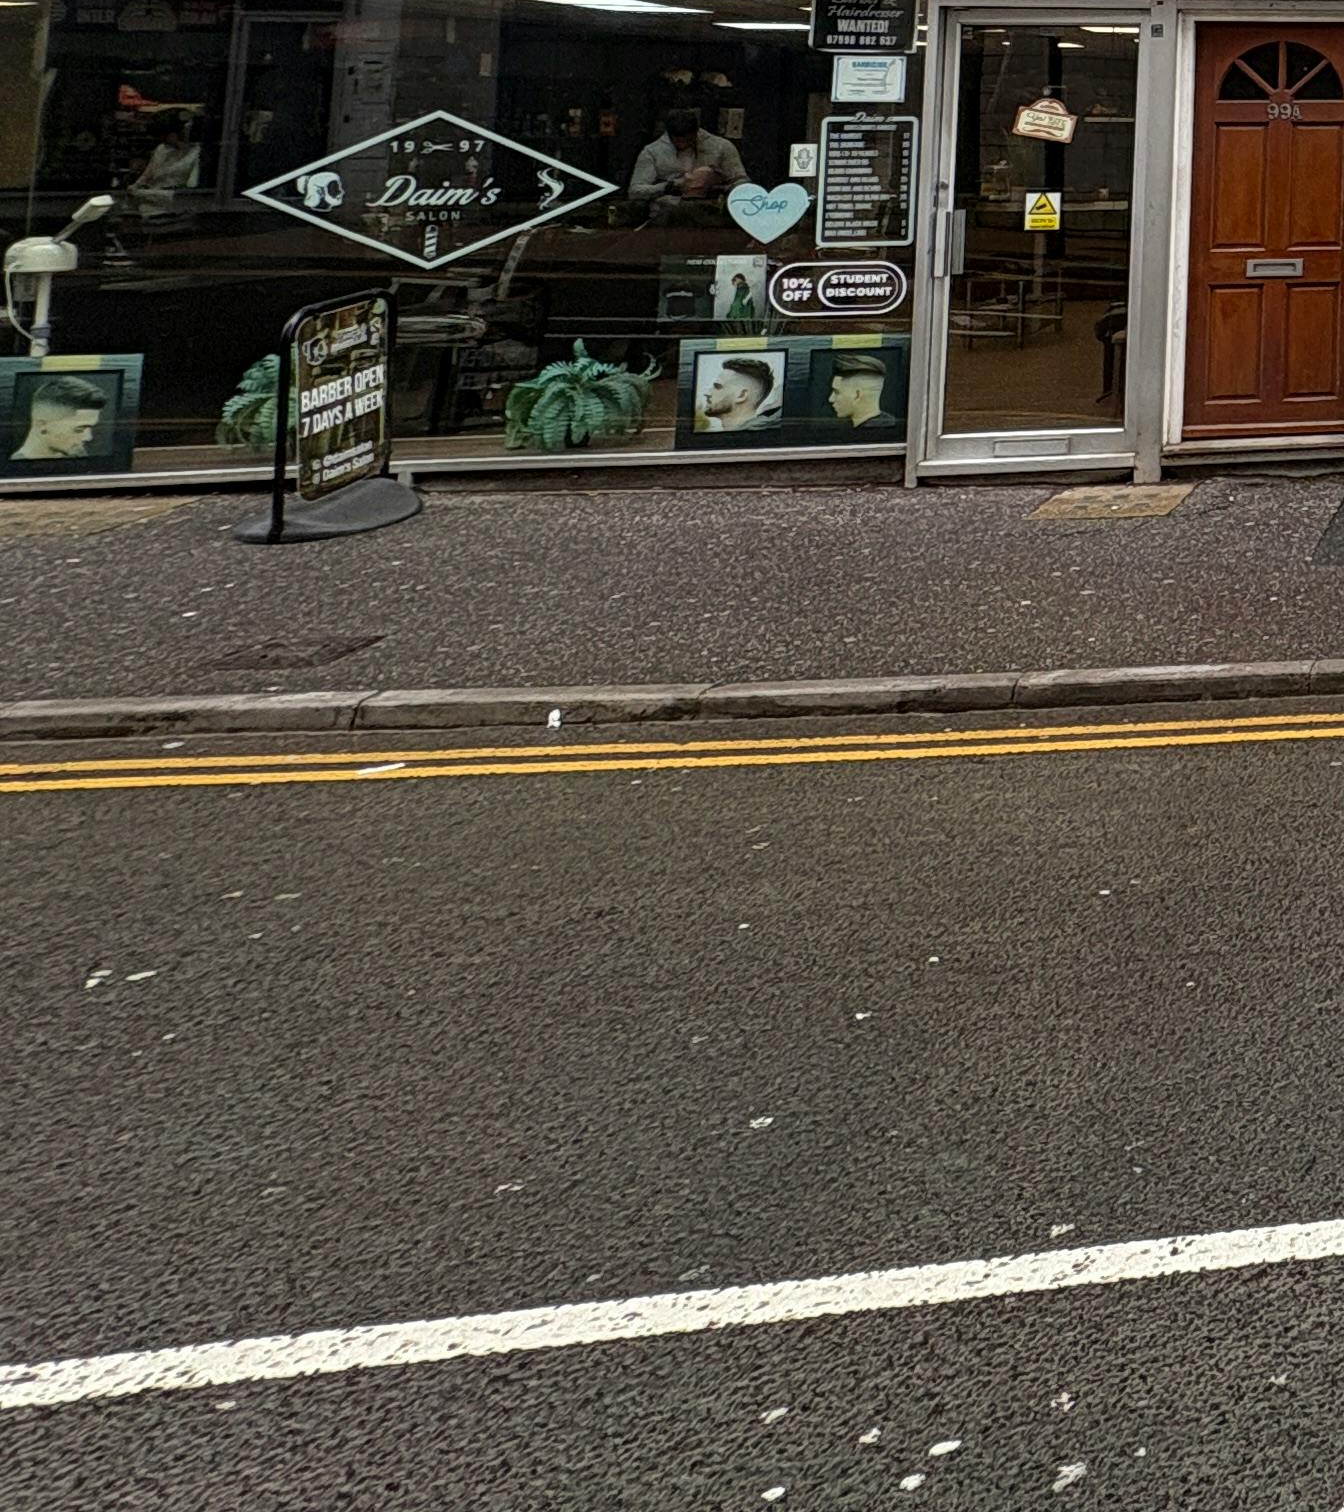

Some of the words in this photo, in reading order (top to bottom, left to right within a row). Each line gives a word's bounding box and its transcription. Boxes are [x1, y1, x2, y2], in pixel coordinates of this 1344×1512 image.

[827, 4, 905, 19] Hairdresser
[837, 18, 890, 33] WANTED!
[1267, 103, 1303, 120] 99A
[366, 175, 502, 207] Daim's
[731, 194, 790, 217] Shop
[404, 210, 461, 222] SALON
[782, 278, 813, 289] 10%
[830, 273, 890, 285] STUDENT
[782, 290, 812, 302] OFF
[825, 286, 893, 298] DISCOUNT
[301, 375, 353, 413] BARBER
[354, 362, 385, 394] OPEN
[301, 417, 312, 438] 7
[312, 405, 344, 436] DAYS
[344, 401, 354, 422] A
[354, 388, 385, 417] WEEK
